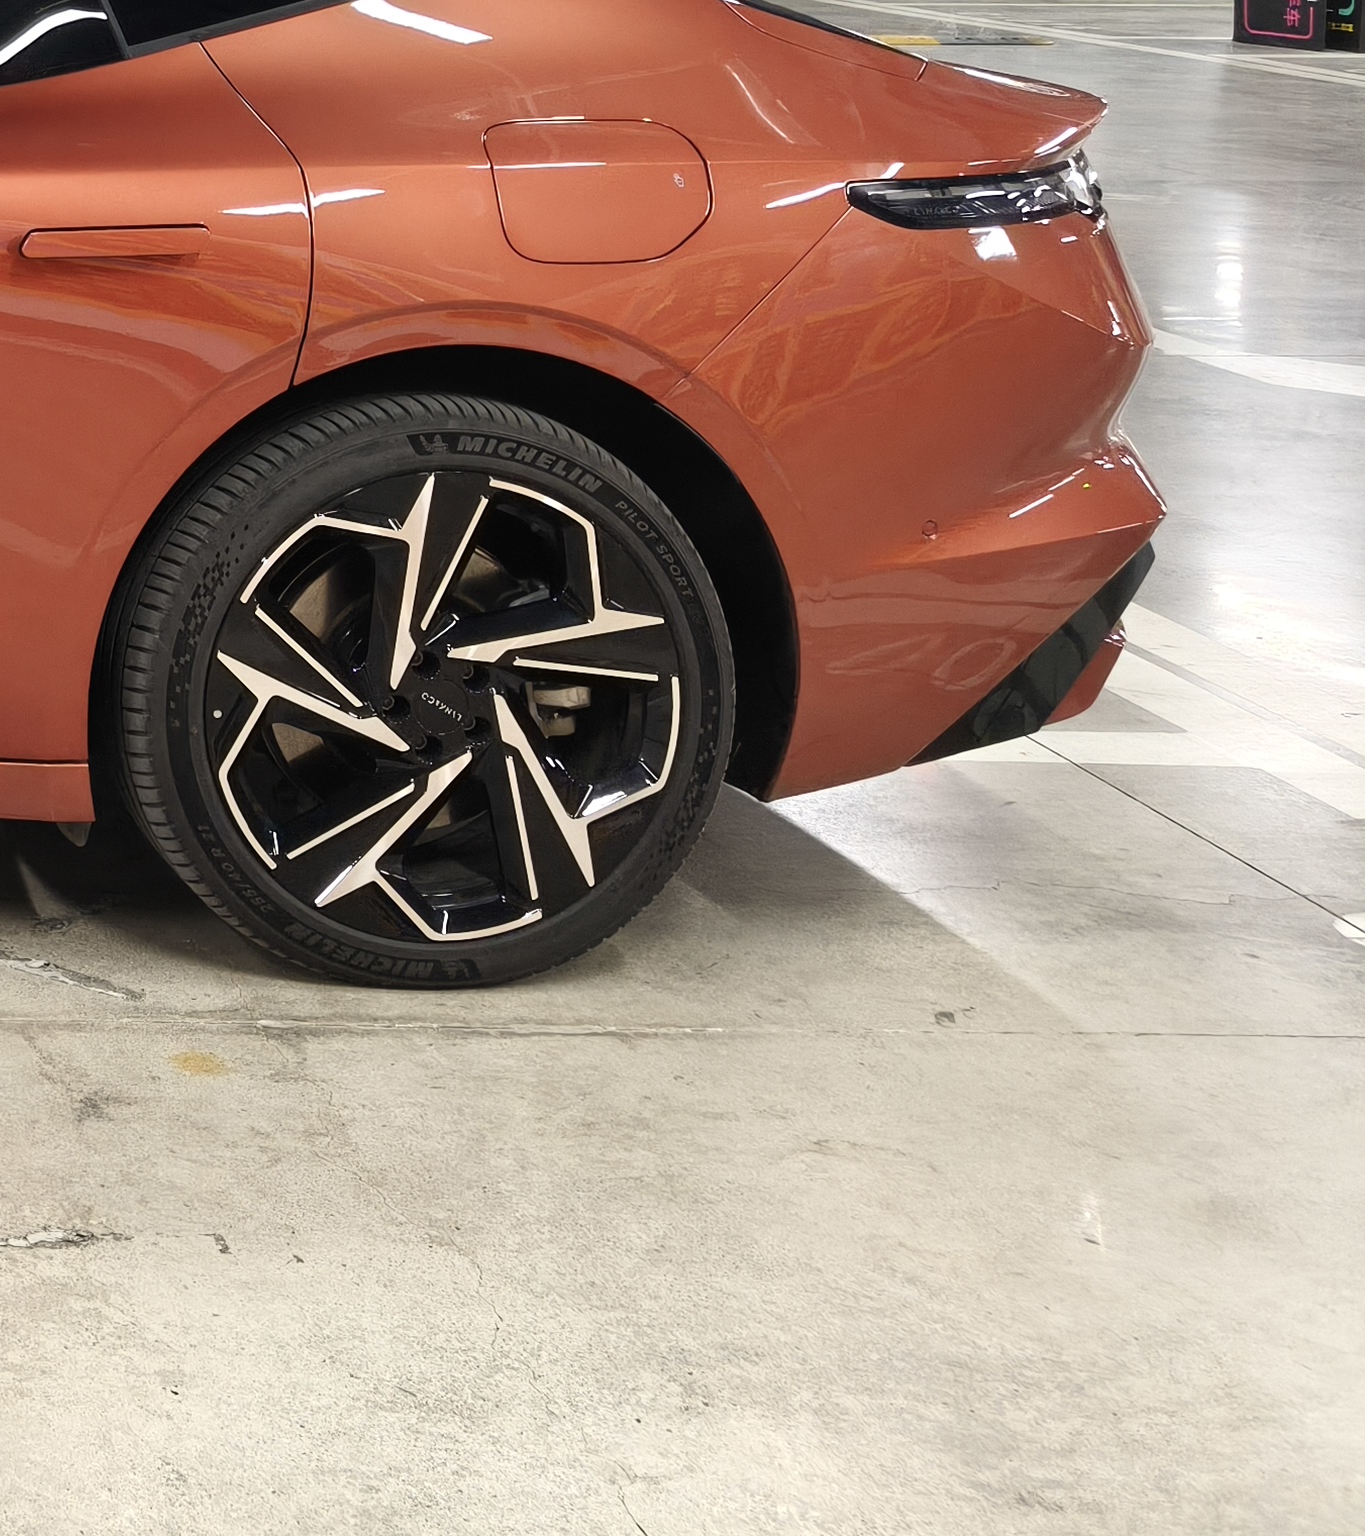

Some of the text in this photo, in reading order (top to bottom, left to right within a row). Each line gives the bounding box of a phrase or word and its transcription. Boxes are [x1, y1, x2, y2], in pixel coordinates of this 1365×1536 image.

[456, 434, 603, 493] MICHELIN
[613, 498, 694, 603] PILOT SPORT
